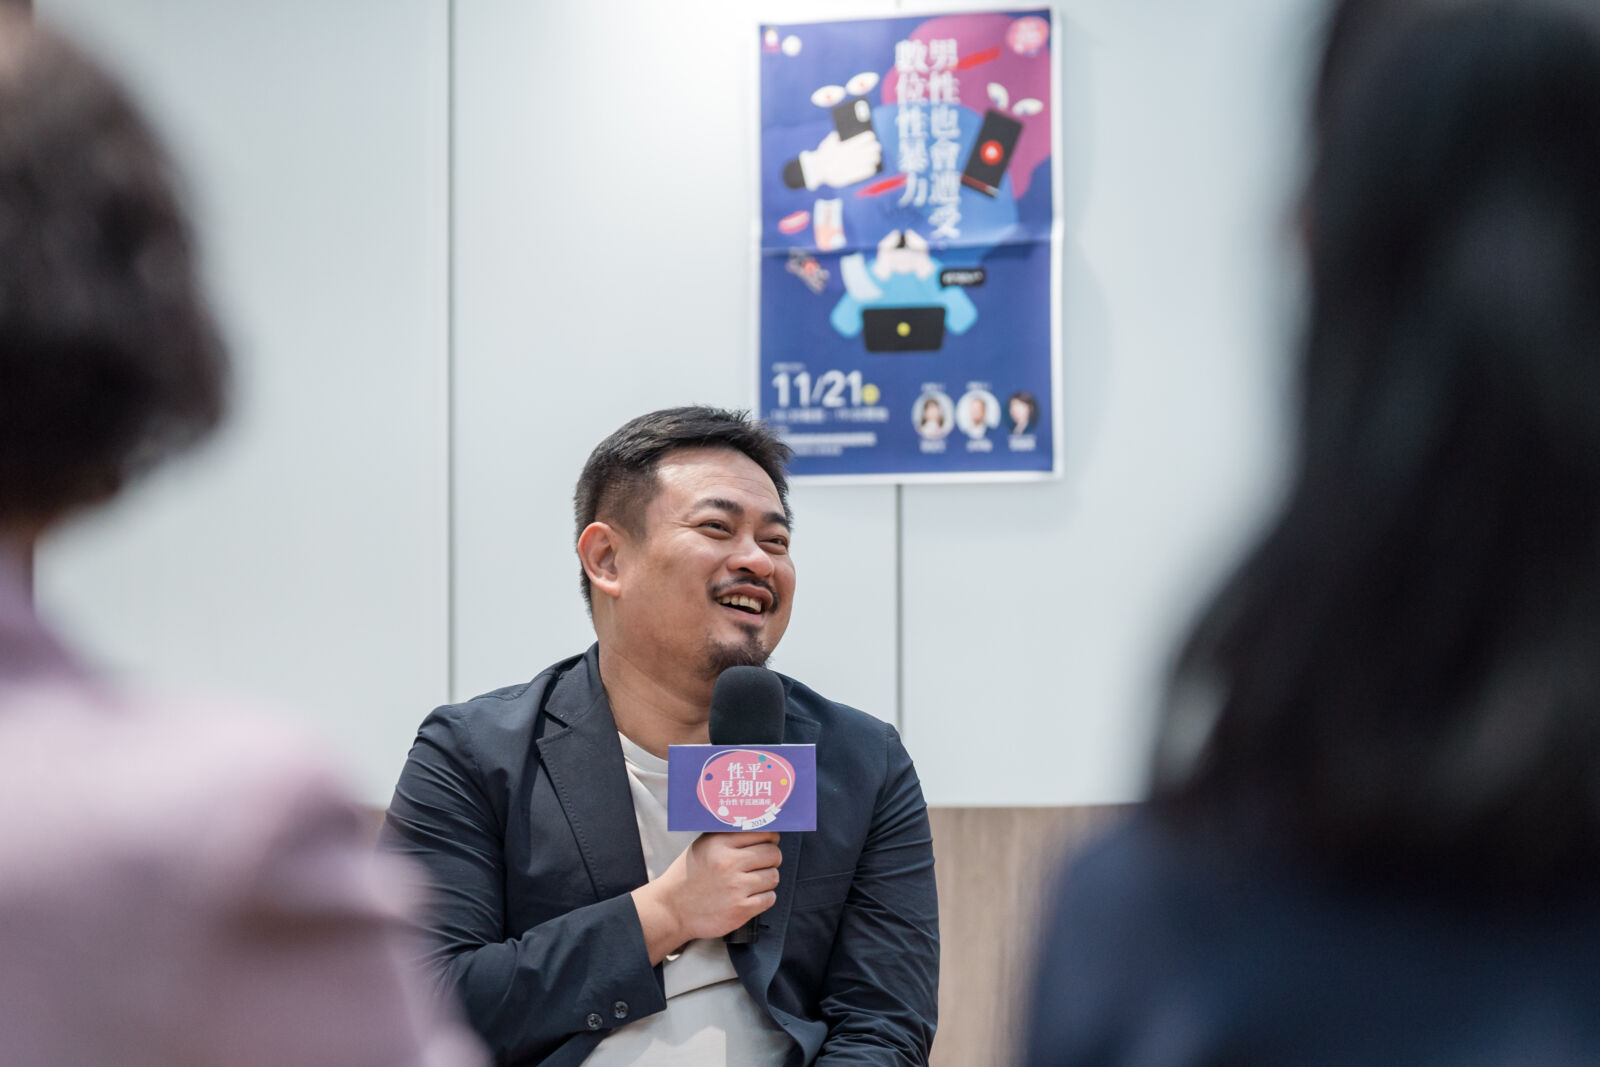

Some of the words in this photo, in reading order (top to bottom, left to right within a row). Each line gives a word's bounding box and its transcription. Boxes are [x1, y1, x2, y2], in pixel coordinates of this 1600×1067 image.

[895, 39, 929, 207] 數位性暴力
[772, 370, 862, 408] 11/21
[727, 762, 764, 780] 性平
[718, 780, 772, 797] 星期四
[751, 818, 767, 828] 2024
